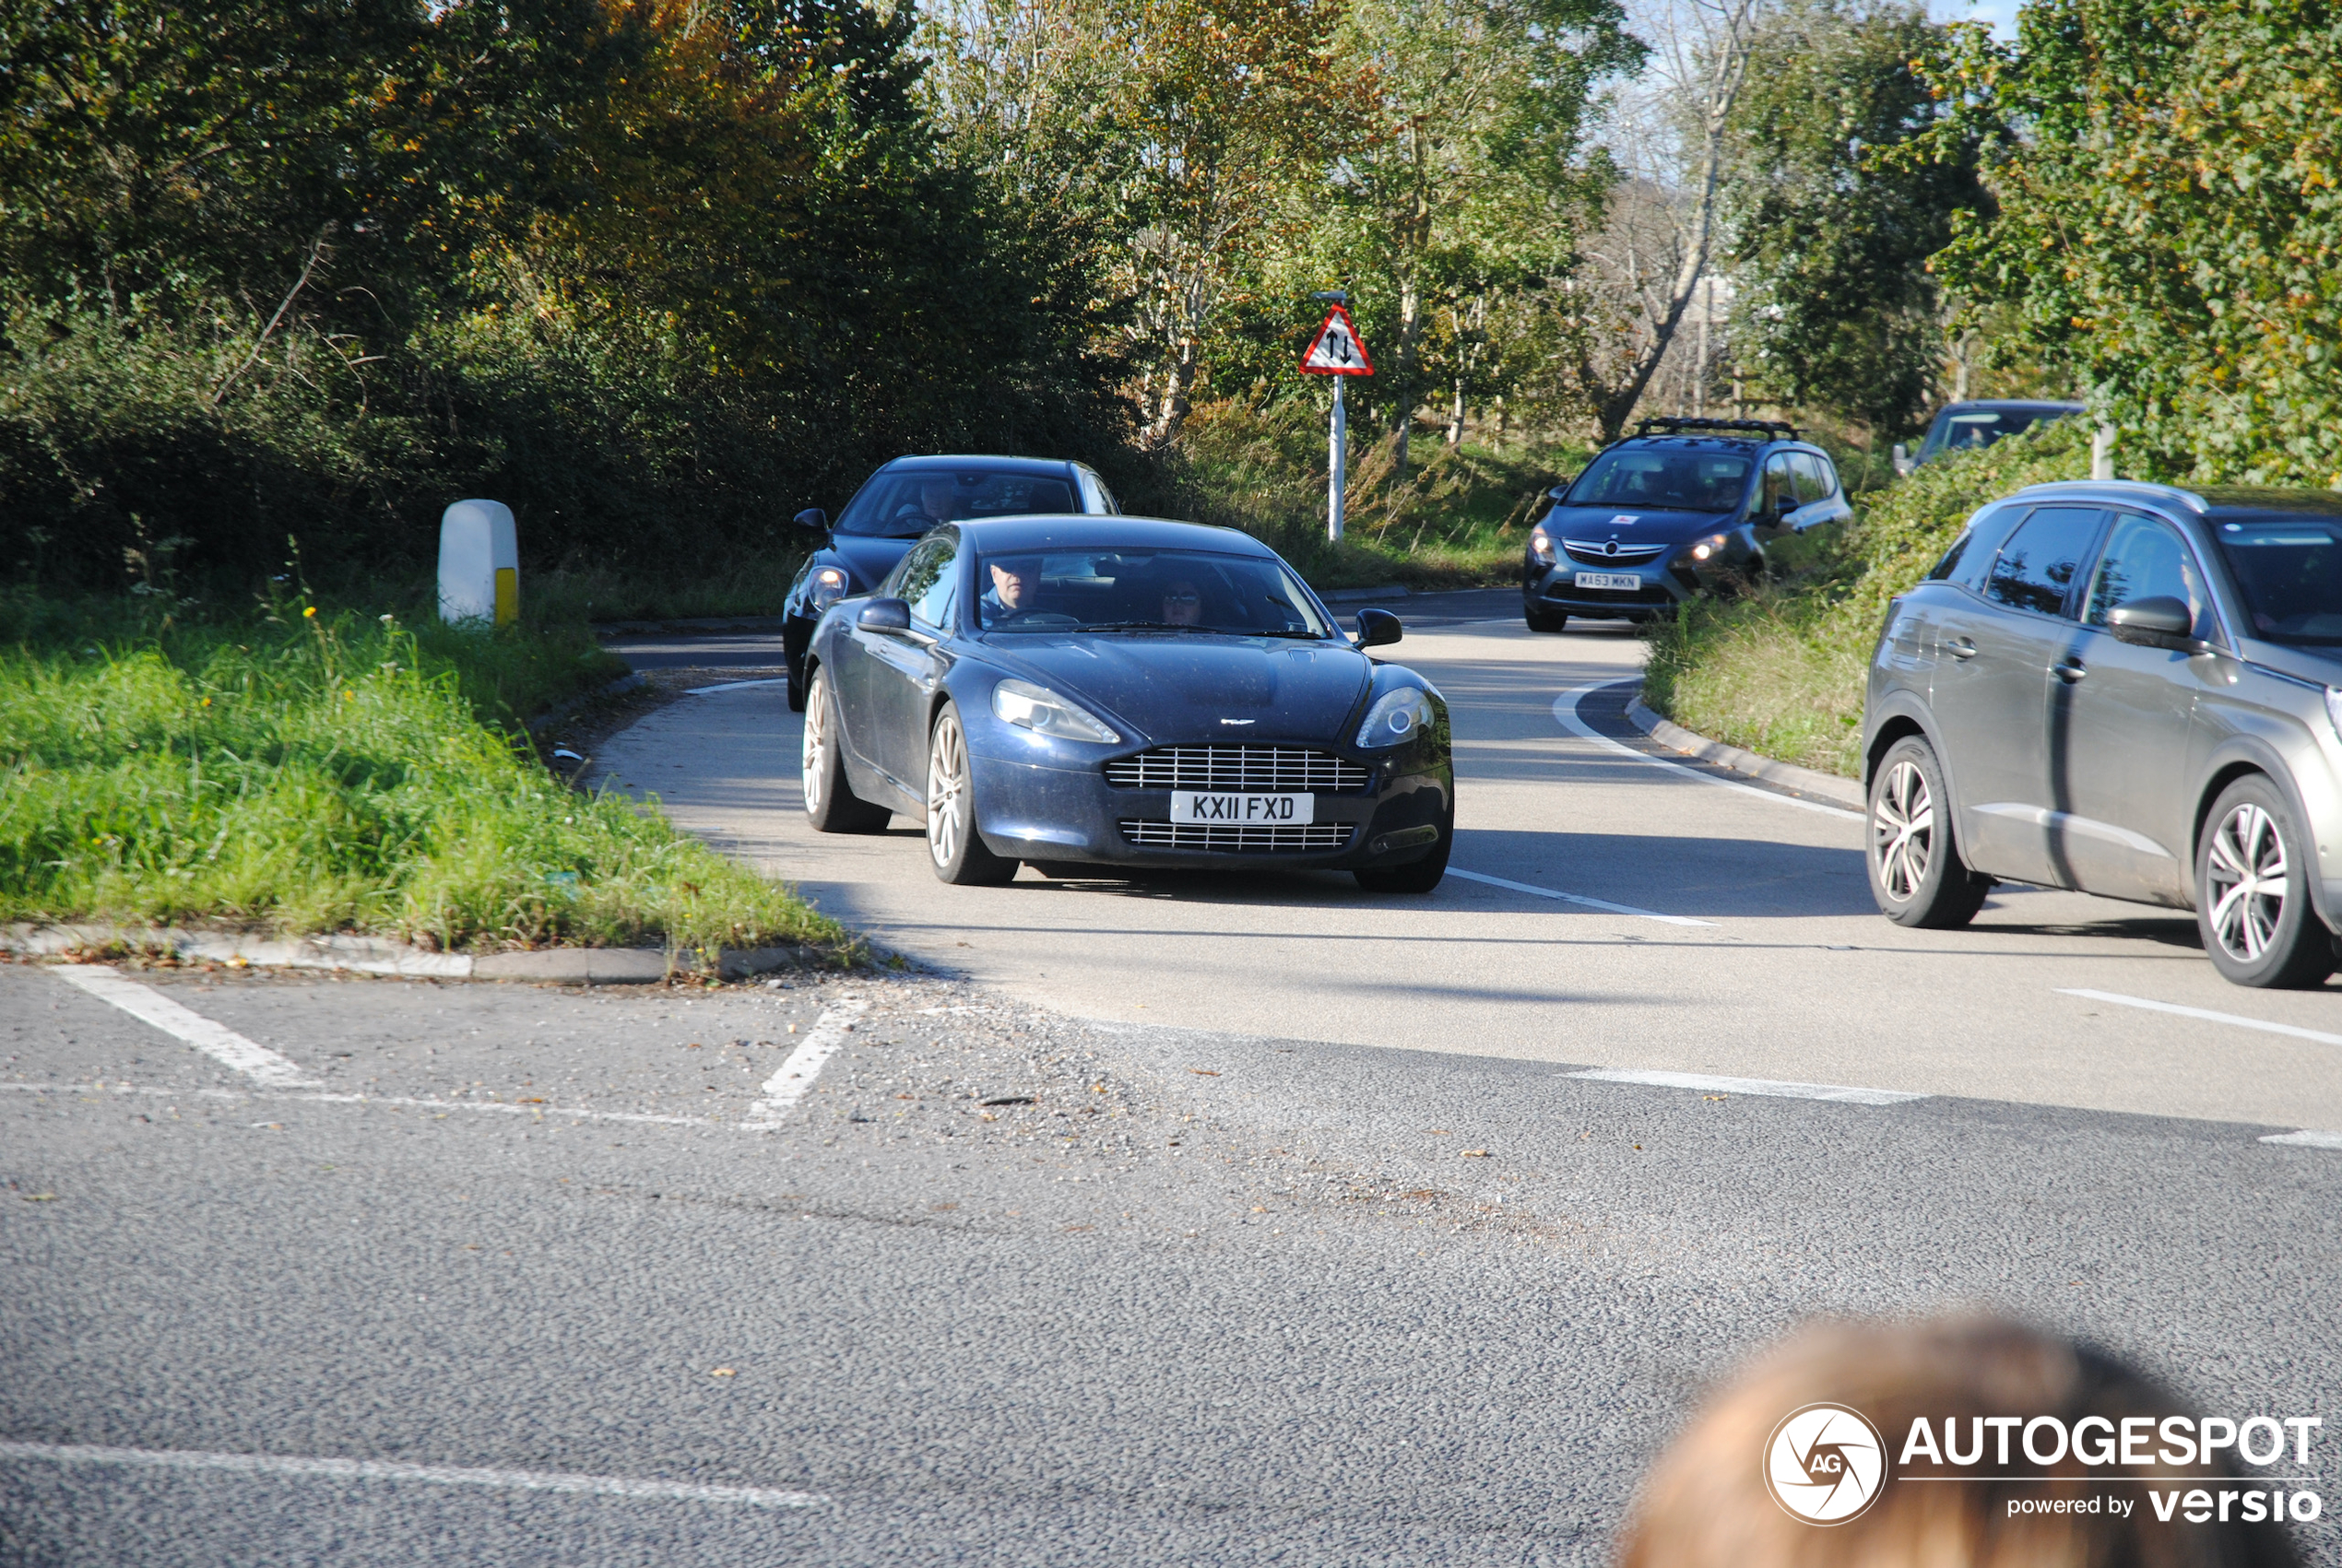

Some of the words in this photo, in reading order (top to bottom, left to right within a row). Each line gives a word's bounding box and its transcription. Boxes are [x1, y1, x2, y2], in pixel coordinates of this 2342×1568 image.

[1579, 574, 1609, 586] MA63
[1612, 575, 1635, 587] MKN
[1192, 796, 1239, 819] KX11
[1247, 796, 1294, 819] FXD
